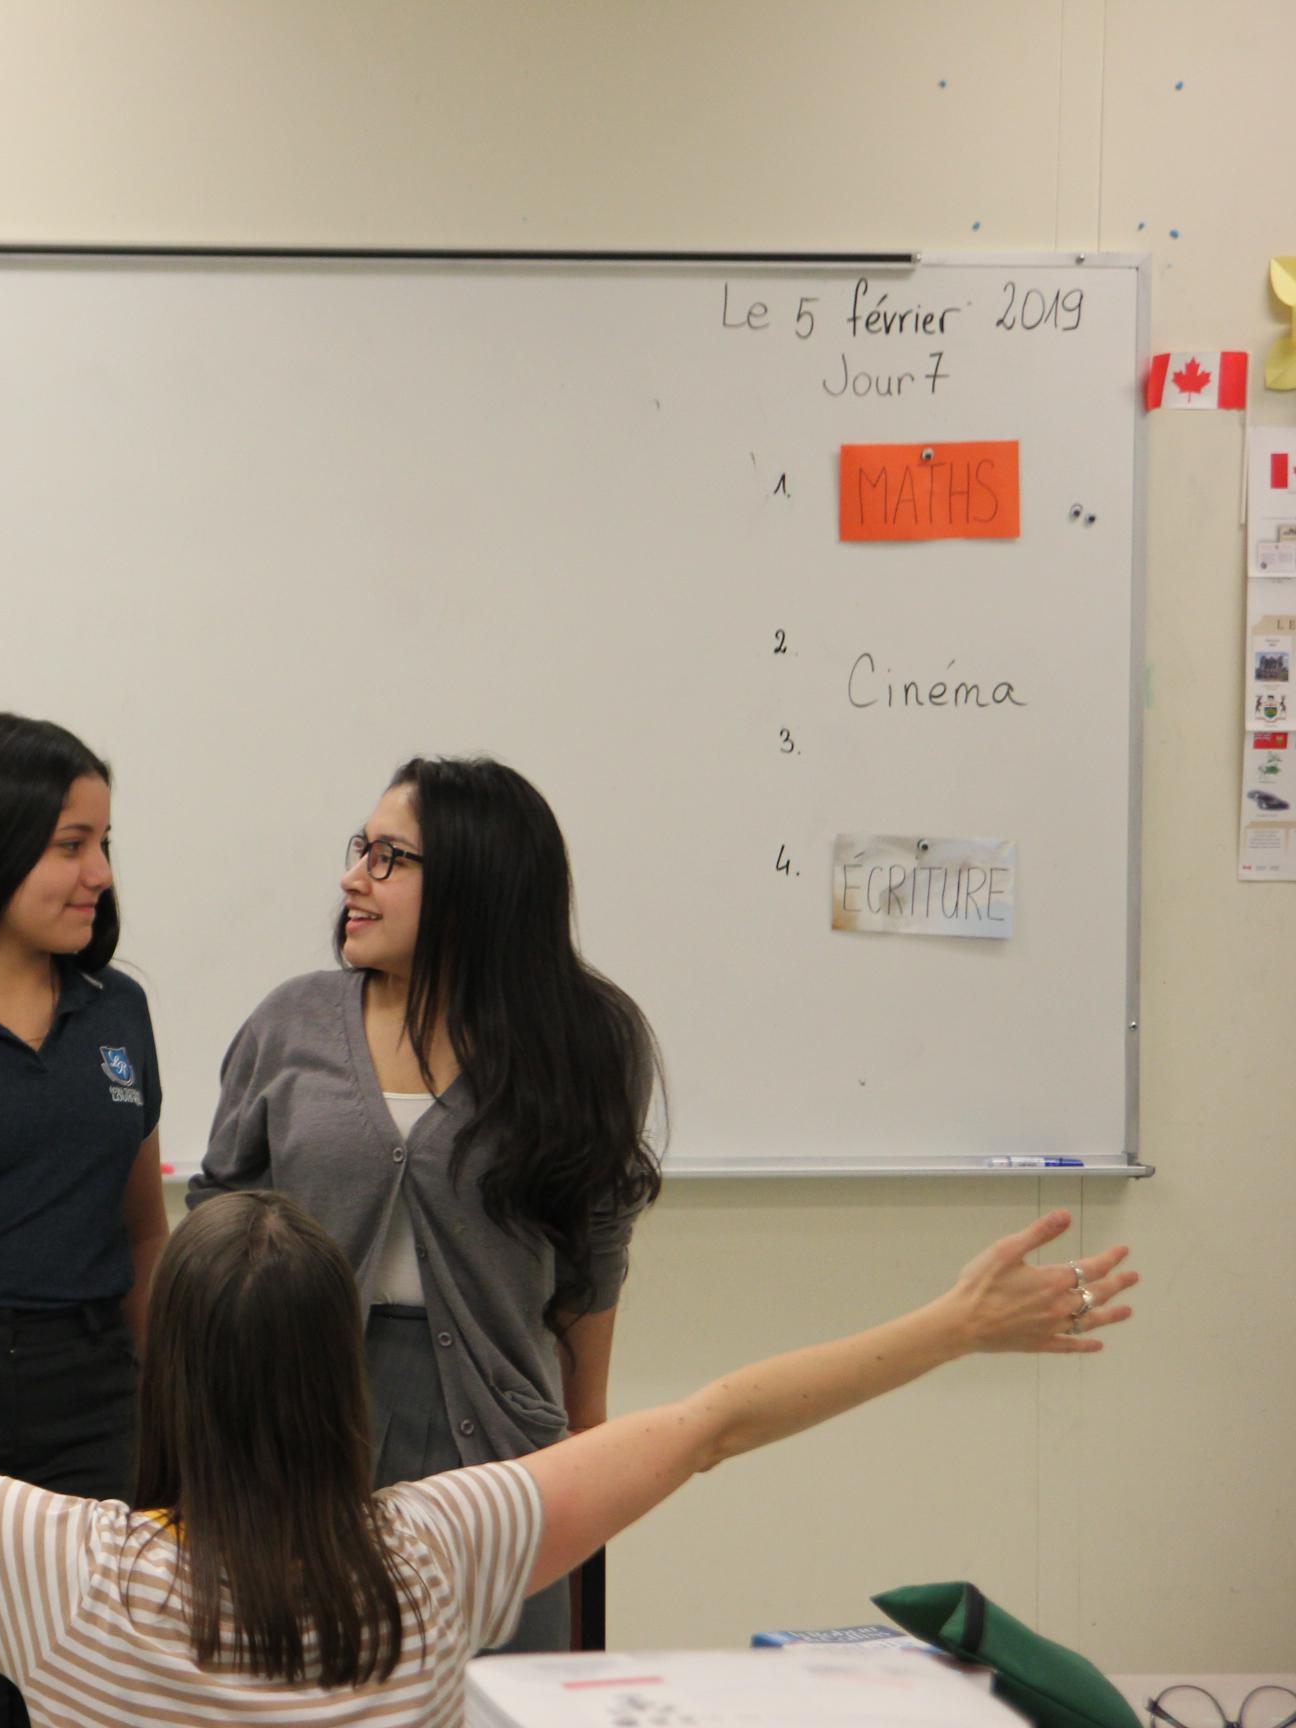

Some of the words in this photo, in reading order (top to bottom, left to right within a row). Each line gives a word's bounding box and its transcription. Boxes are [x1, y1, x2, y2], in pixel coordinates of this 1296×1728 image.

[721, 281, 769, 329] Le
[795, 296, 819, 340] 5
[847, 277, 961, 337] février
[995, 281, 1084, 332] 2019
[822, 353, 914, 396] Jour
[924, 352, 950, 394] 7
[859, 459, 999, 525] MATHS
[848, 652, 1028, 708] Cinéma
[776, 844, 801, 877] 4.
[842, 851, 1009, 922] ÉCRITURE
